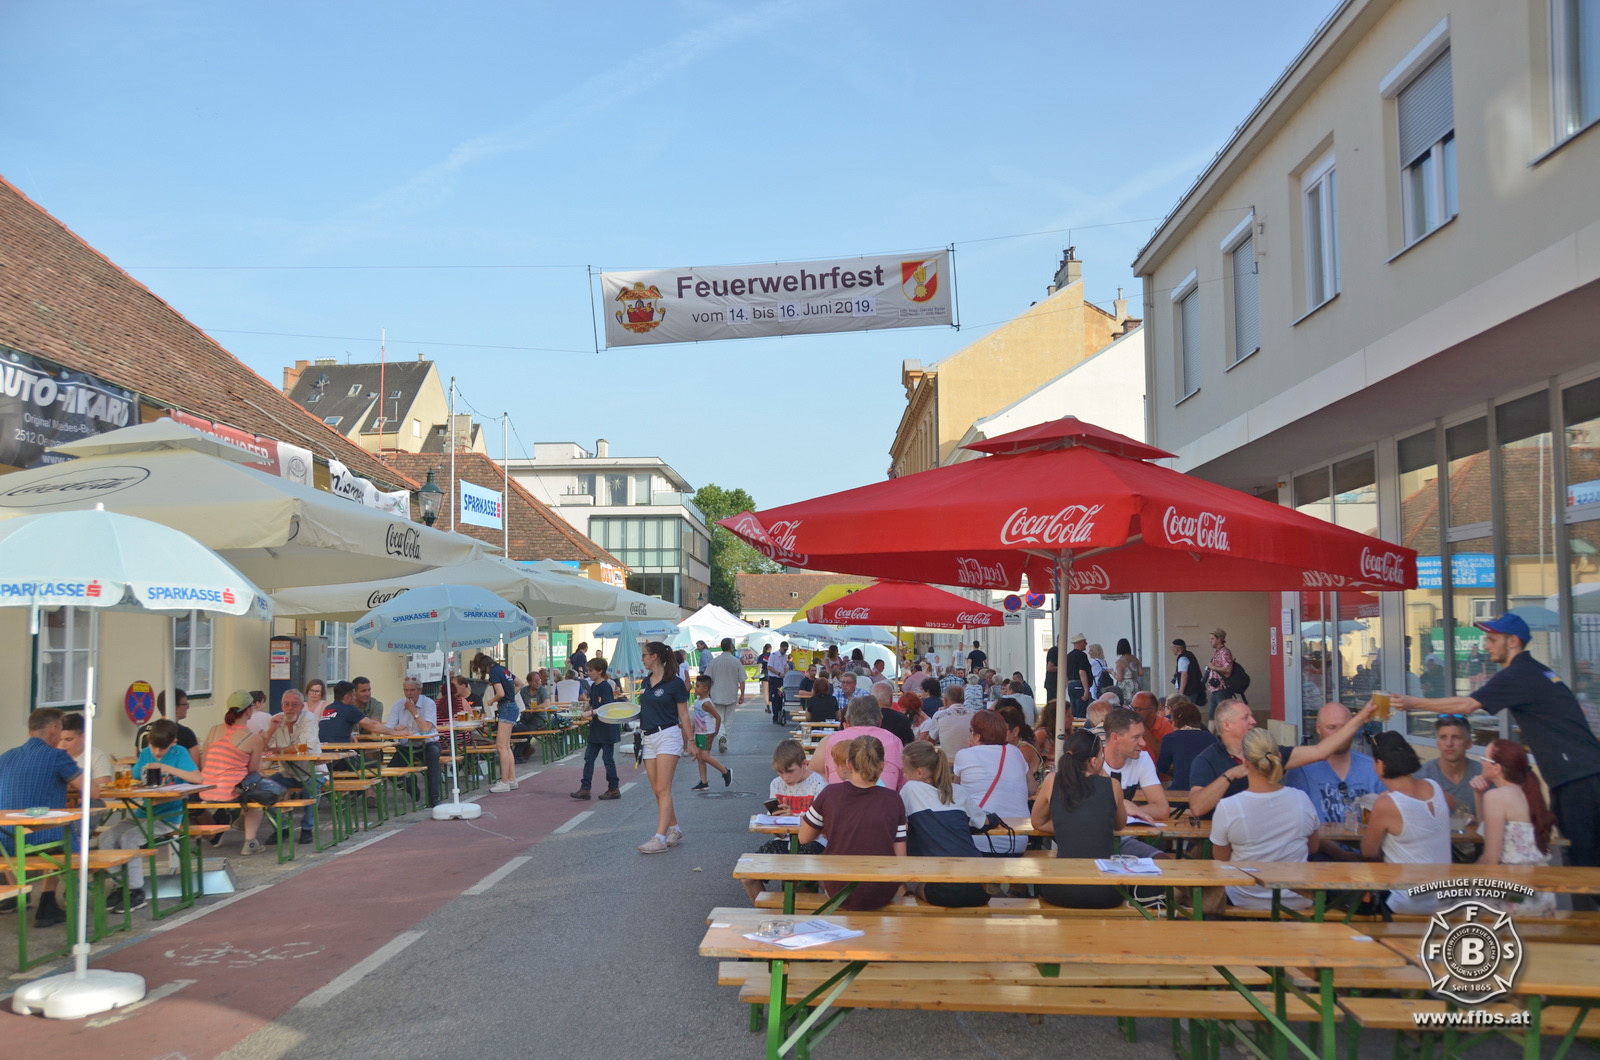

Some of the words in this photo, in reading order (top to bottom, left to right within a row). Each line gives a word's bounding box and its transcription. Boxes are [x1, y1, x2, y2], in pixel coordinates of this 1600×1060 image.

[677, 265, 885, 299] Feuerwehrfest
[692, 311, 724, 323] vom
[729, 308, 749, 321] 14.
[752, 306, 775, 319] bis
[779, 304, 800, 318] 16.
[803, 301, 832, 316] Juni
[835, 300, 874, 314] 2019.
[15, 428, 36, 444] 2512
[463, 493, 497, 517] SPARKASSE
[1000, 504, 1105, 545] Coca-Cola
[1163, 506, 1230, 551] Coca-Cola
[386, 523, 421, 560] Coca-Cola
[1361, 546, 1404, 585] Coca-Cola
[148, 586, 222, 603] SPARKASSE
[392, 612, 431, 623] SPARKASSE
[463, 611, 498, 619] SPARKASSE
[834, 607, 870, 620] Coca-Cola
[956, 612, 992, 625] Coca-Cola
